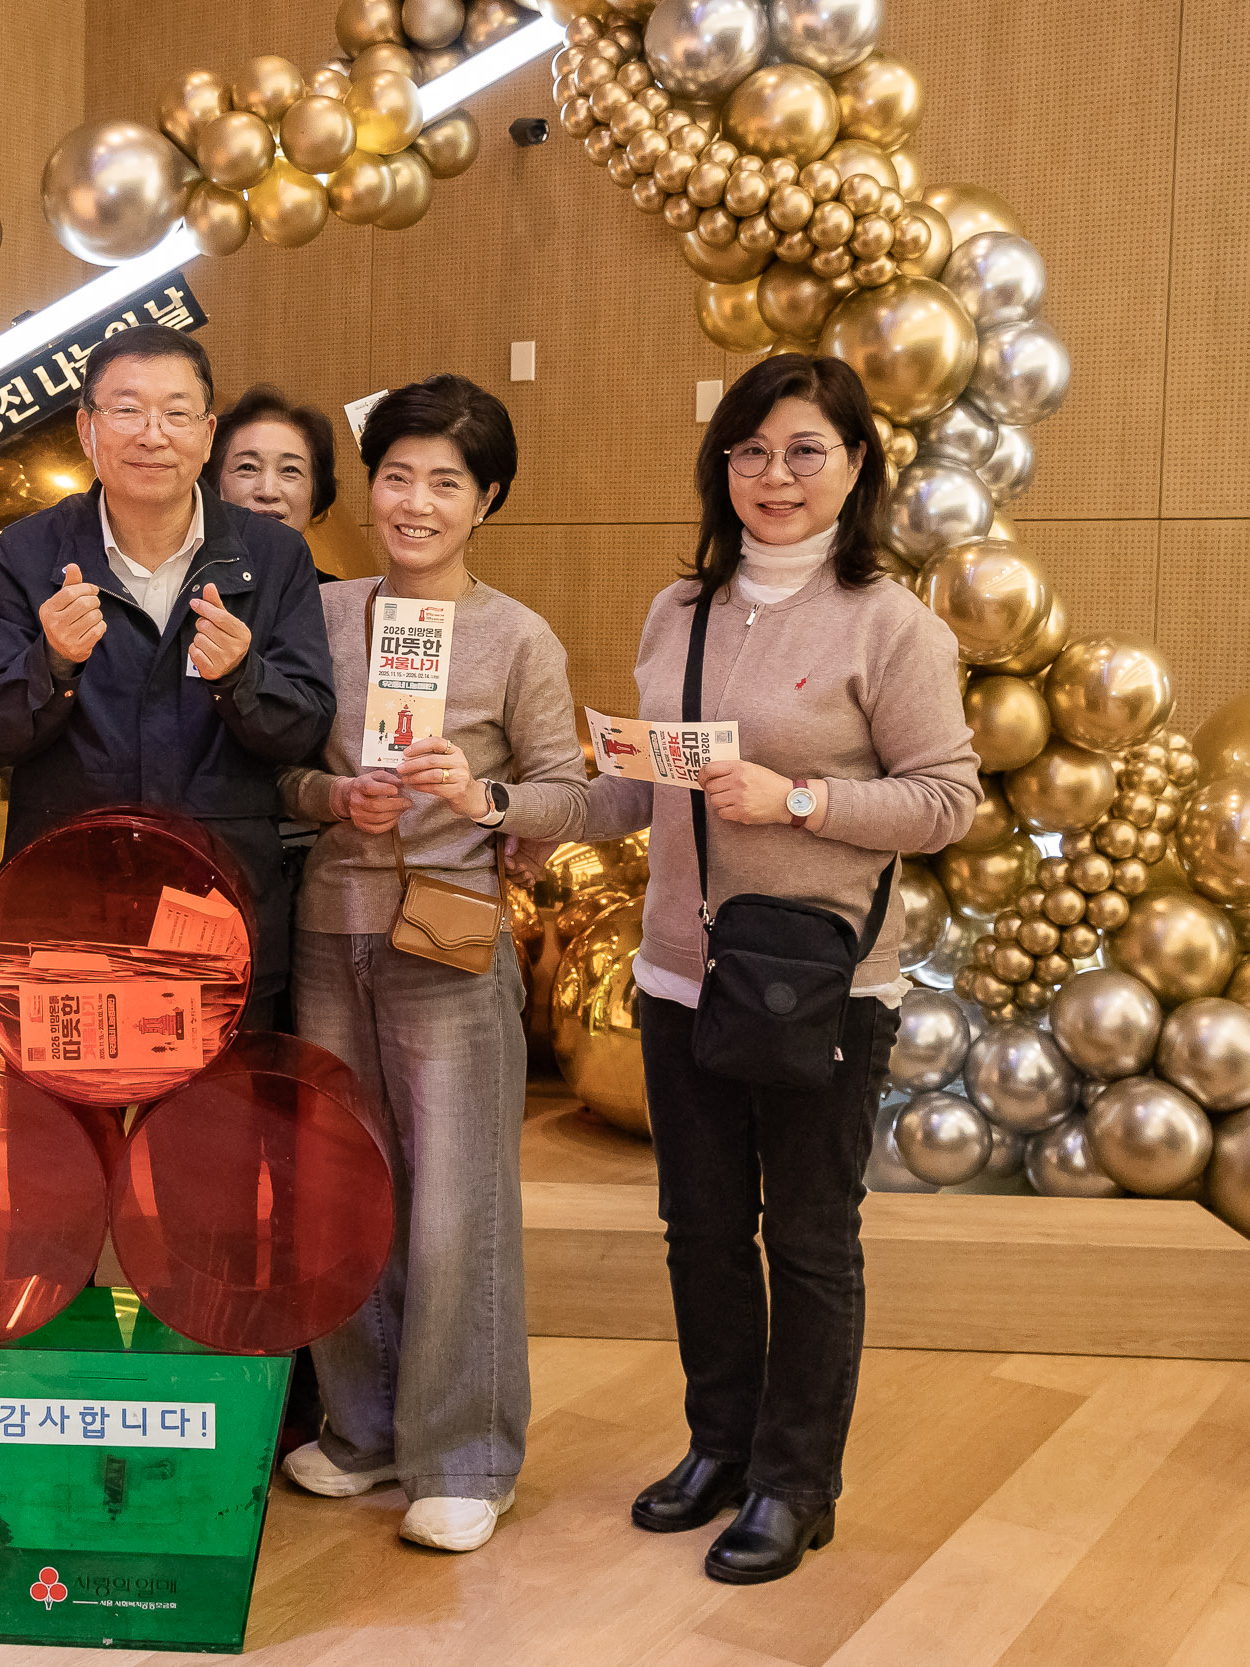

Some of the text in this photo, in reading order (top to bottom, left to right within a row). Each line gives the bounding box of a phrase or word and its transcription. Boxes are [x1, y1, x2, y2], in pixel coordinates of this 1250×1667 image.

[143, 286, 195, 330] 날
[383, 626, 406, 636] 2026
[380, 636, 442, 657] 따뜻한
[379, 656, 439, 672] 겨울나기
[701, 732, 710, 754] 2026
[667, 731, 689, 781] 겨울나기
[61, 994, 81, 1060] 따뜻한
[51, 1036, 60, 1059] 2026
